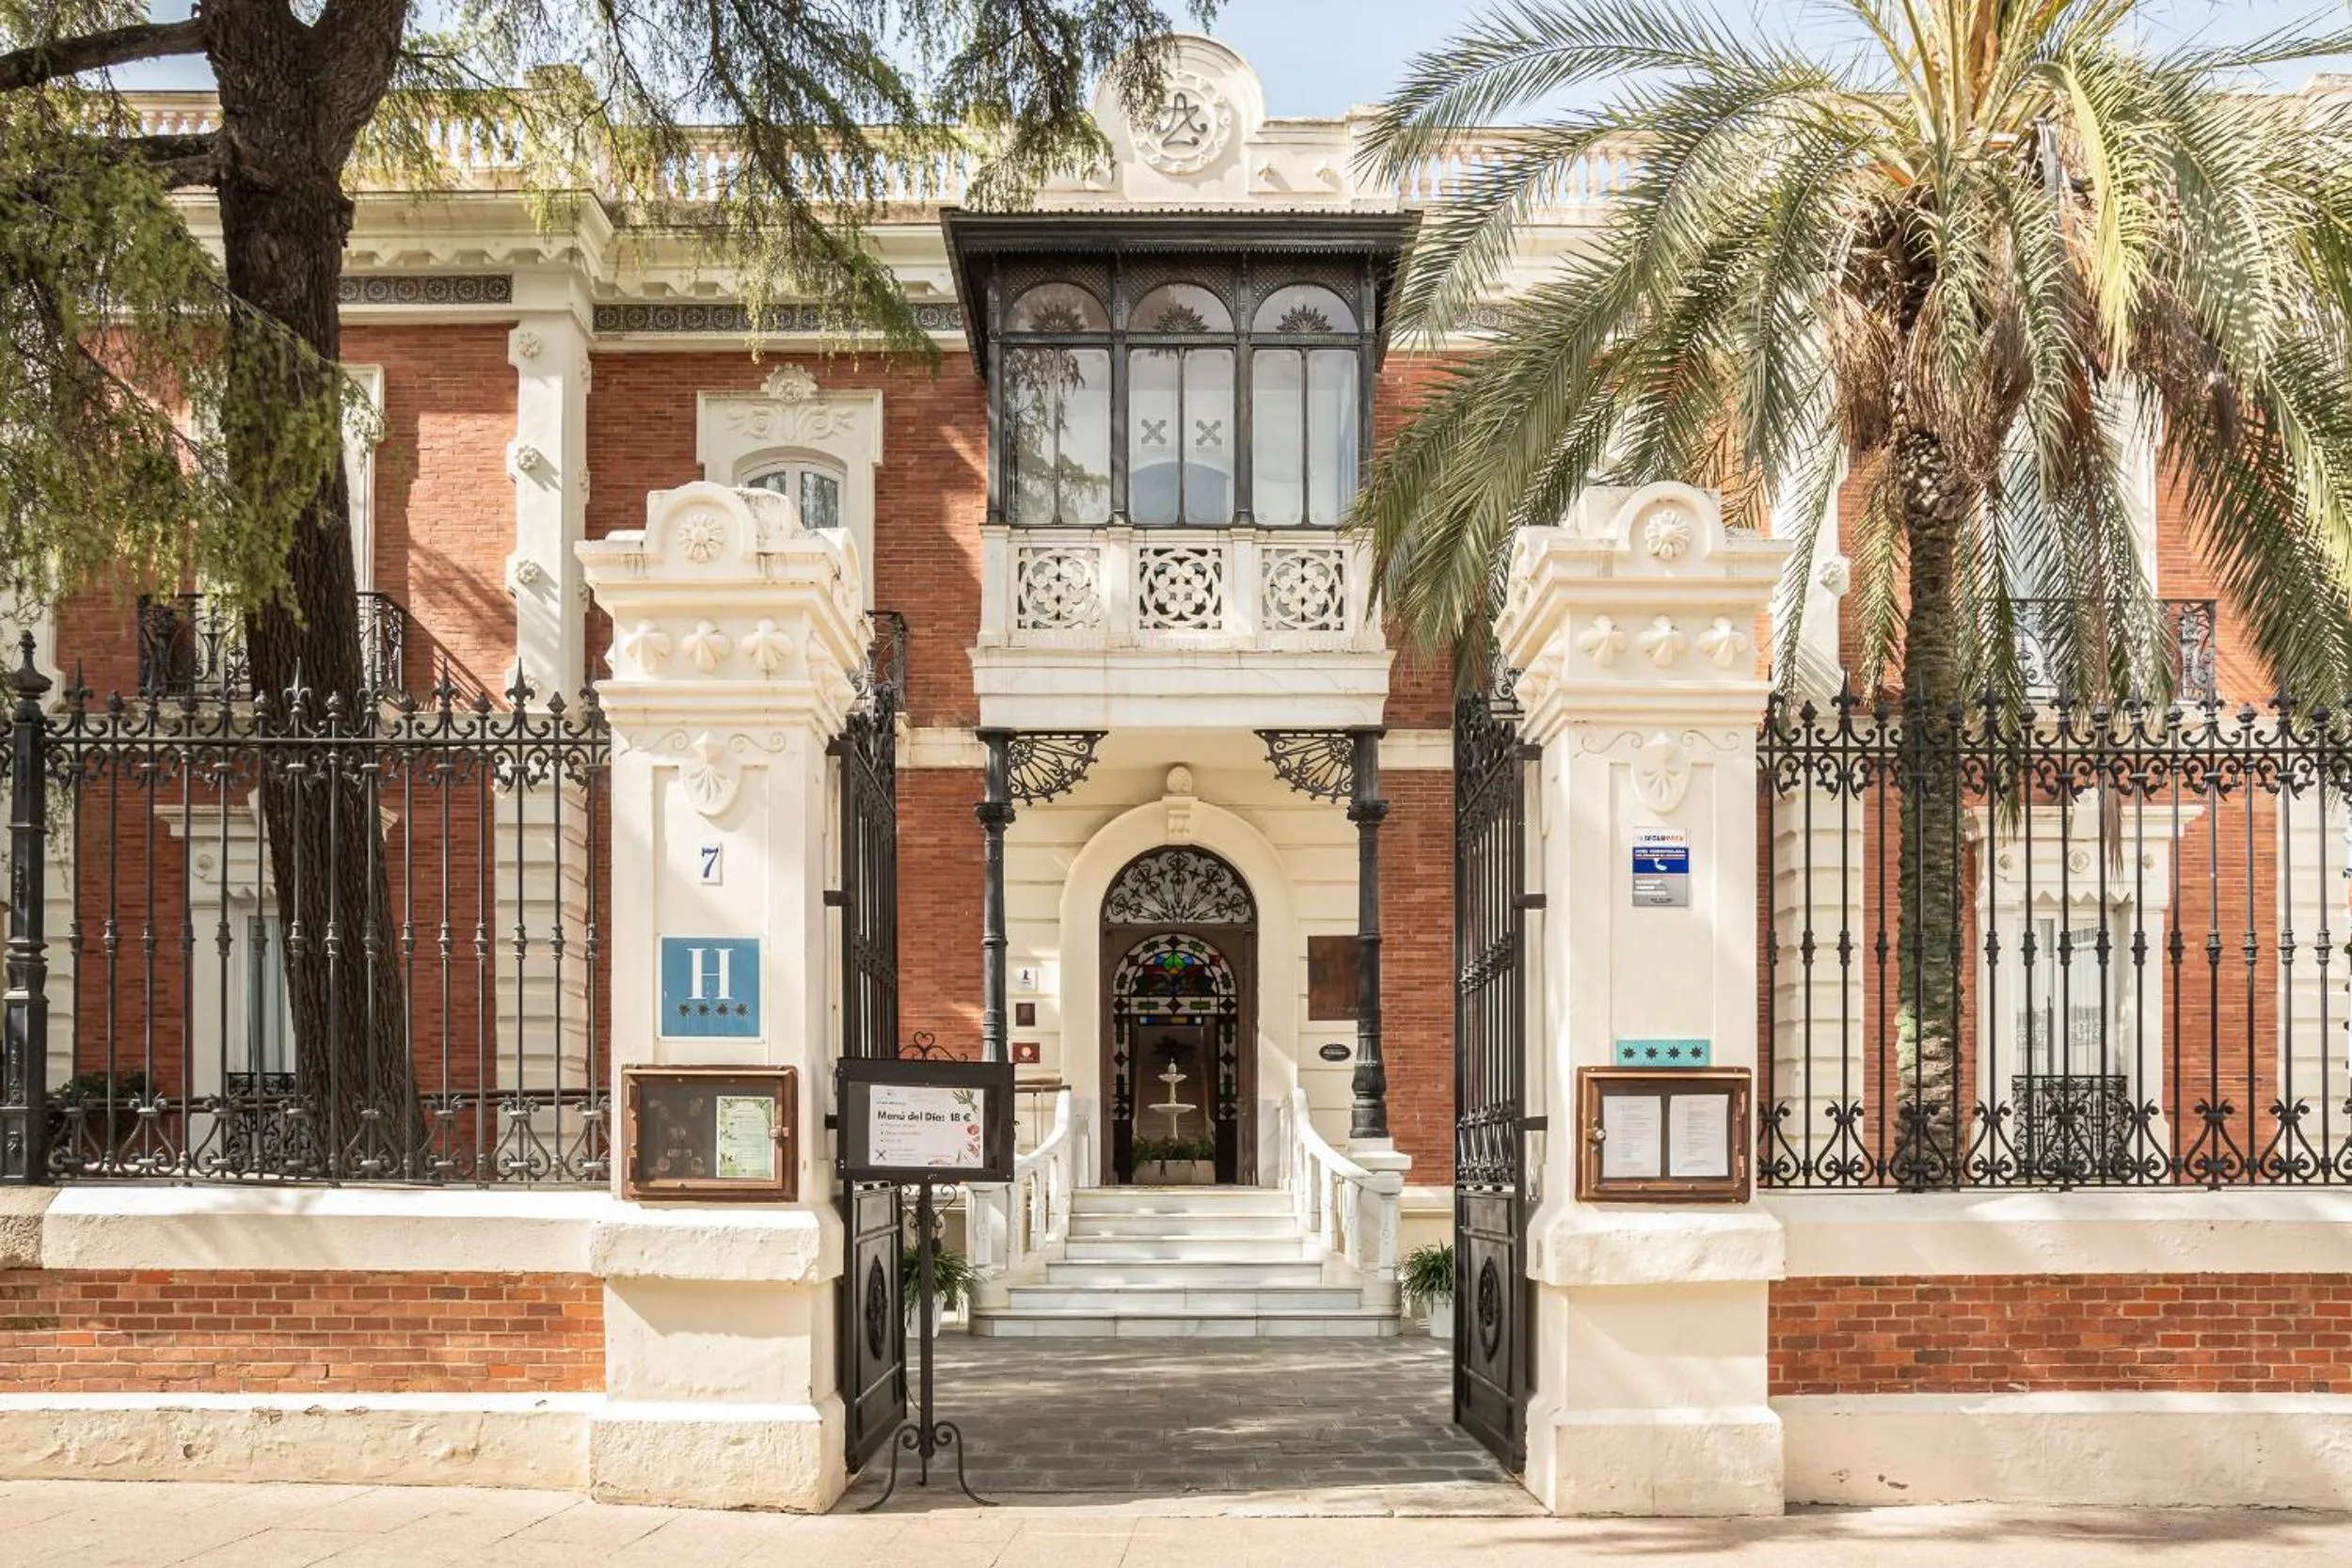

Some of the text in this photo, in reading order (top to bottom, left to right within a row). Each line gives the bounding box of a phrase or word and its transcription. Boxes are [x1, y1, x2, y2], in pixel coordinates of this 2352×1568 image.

[702, 847, 719, 878] 7
[686, 947, 735, 1000] H
[877, 1110, 905, 1121] Menú
[907, 1111, 923, 1121] del
[950, 1112, 960, 1122] 18
[963, 1113, 971, 1122] €
